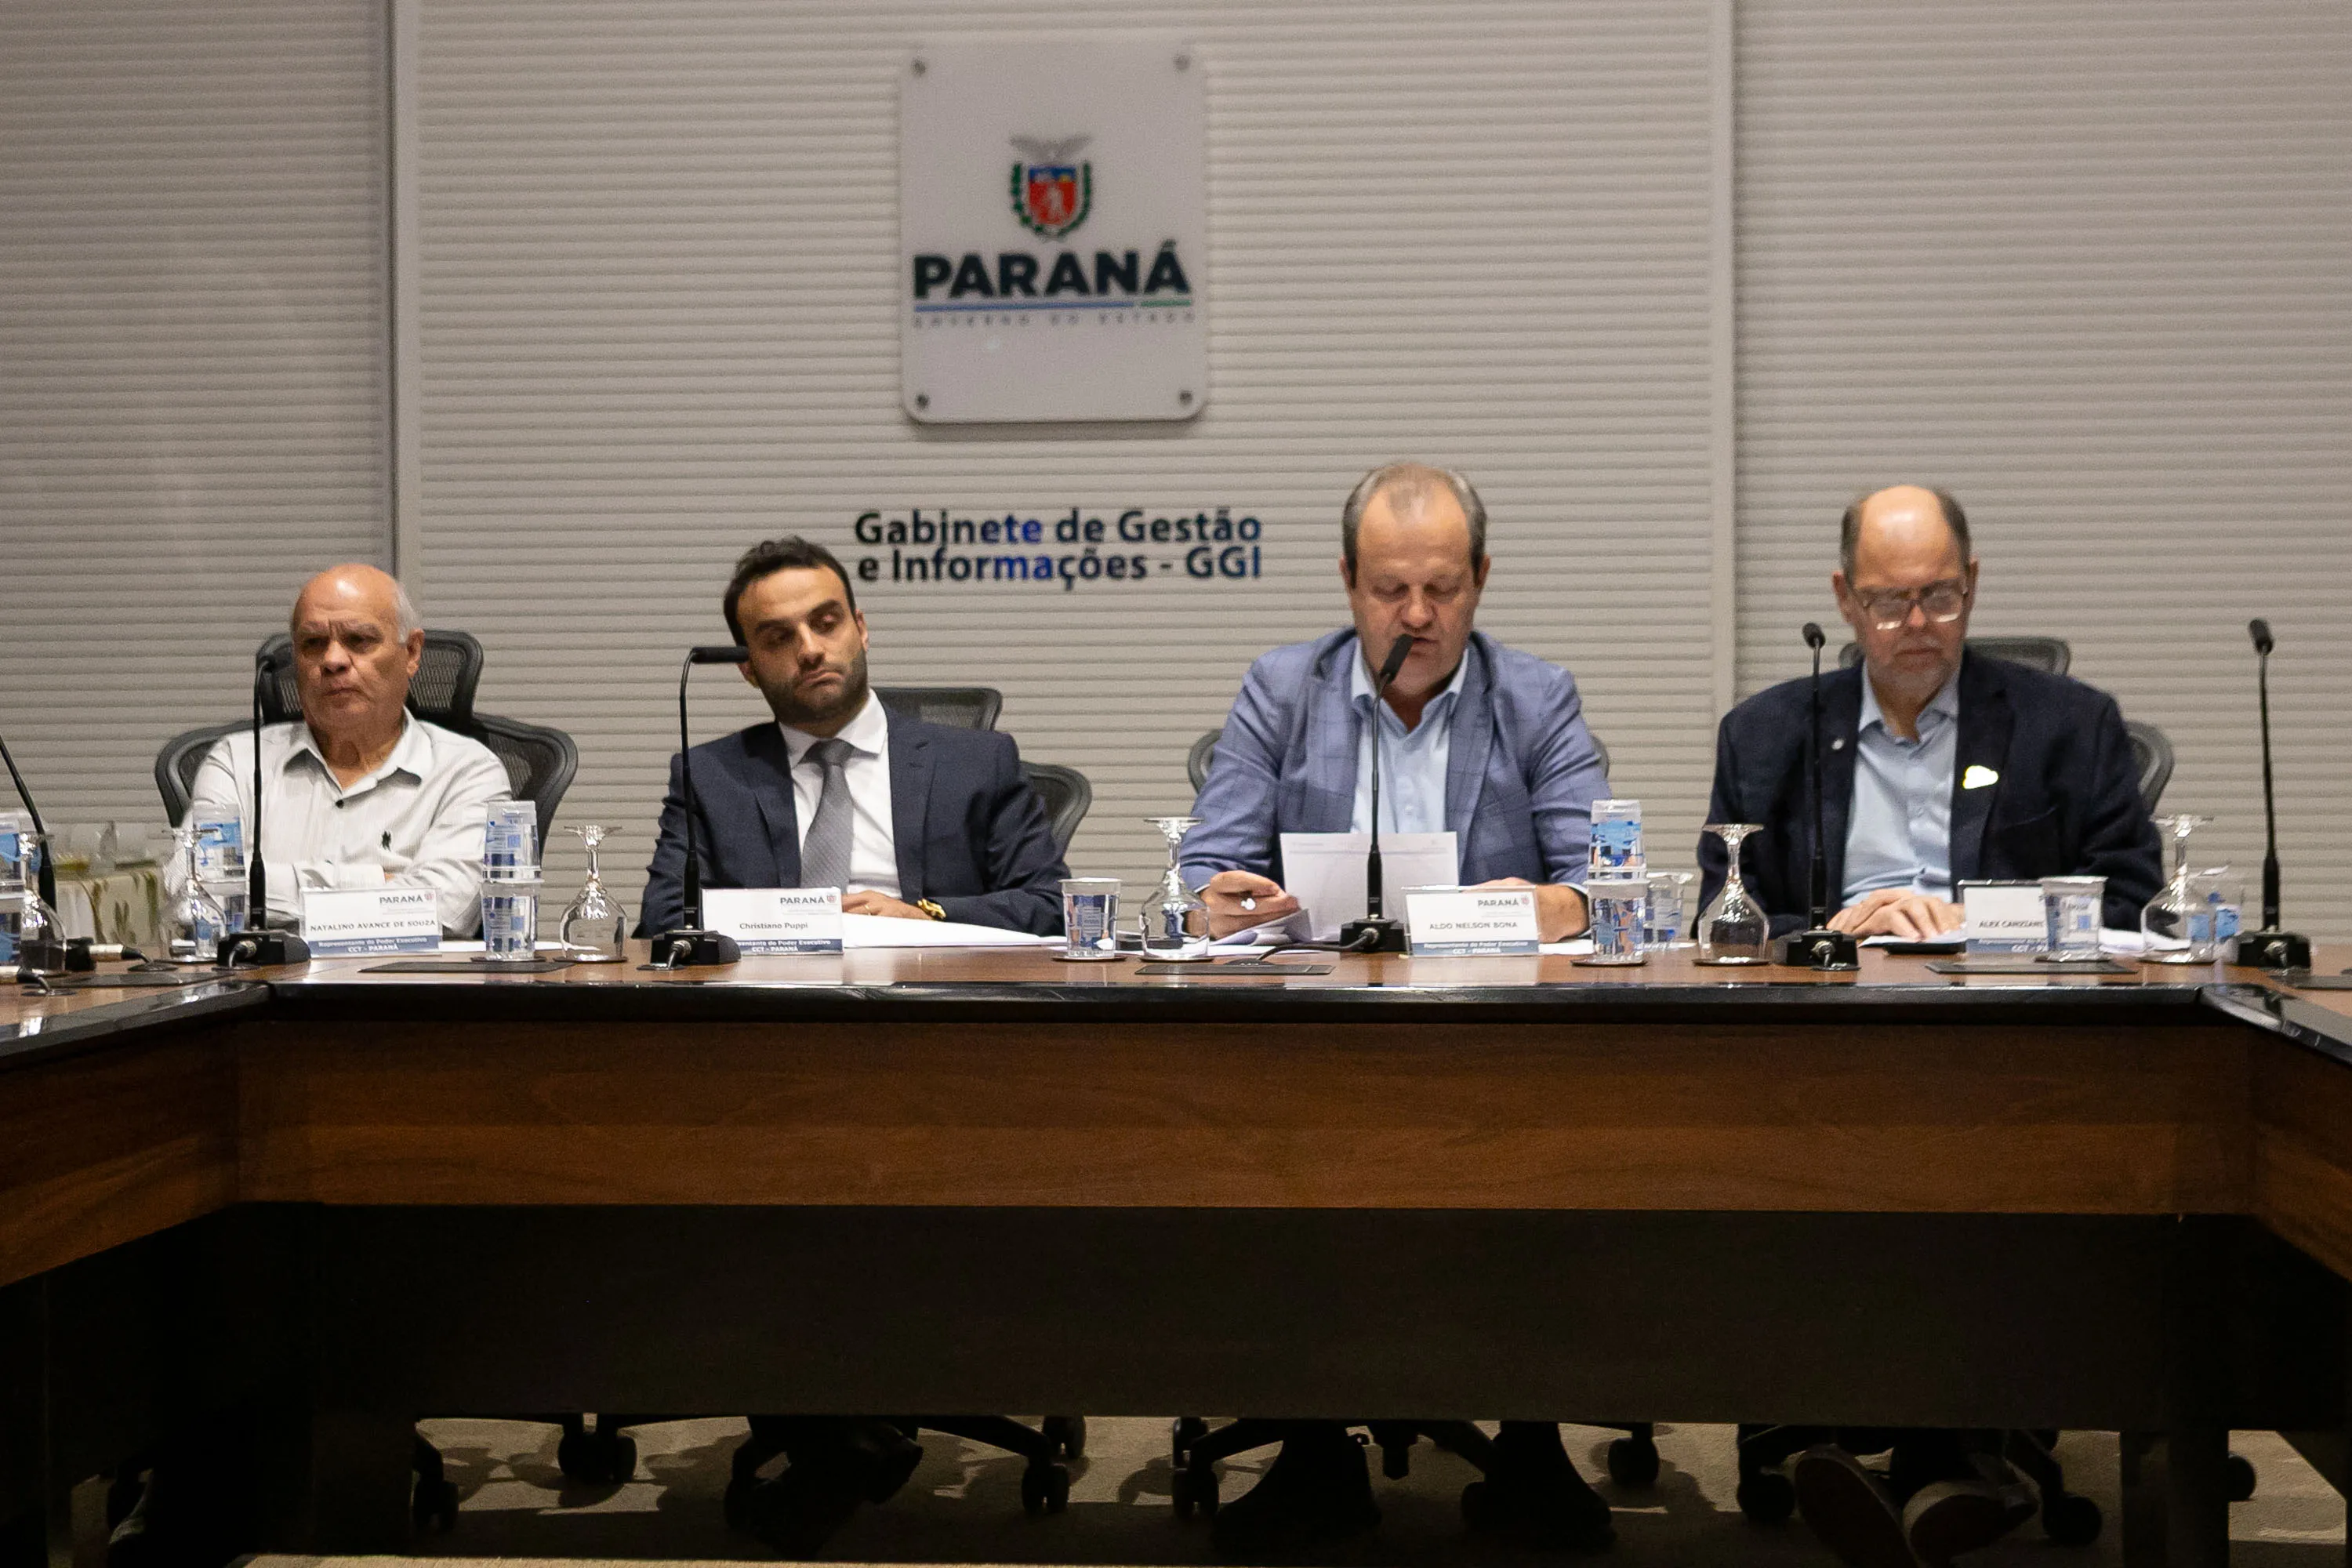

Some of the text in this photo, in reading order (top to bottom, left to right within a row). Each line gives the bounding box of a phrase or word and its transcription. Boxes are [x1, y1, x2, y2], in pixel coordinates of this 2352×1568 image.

[913, 240, 1191, 299] PARANÁ
[855, 506, 1262, 545] Gabinete de Gestão
[858, 554, 879, 581] e
[892, 547, 1147, 591] Informações
[1186, 546, 1261, 579] GGI
[379, 894, 423, 904] PARANÁ
[780, 895, 825, 904] PARANÁ
[1477, 898, 1519, 906] PARANÁ
[784, 922, 808, 931] Puppi
